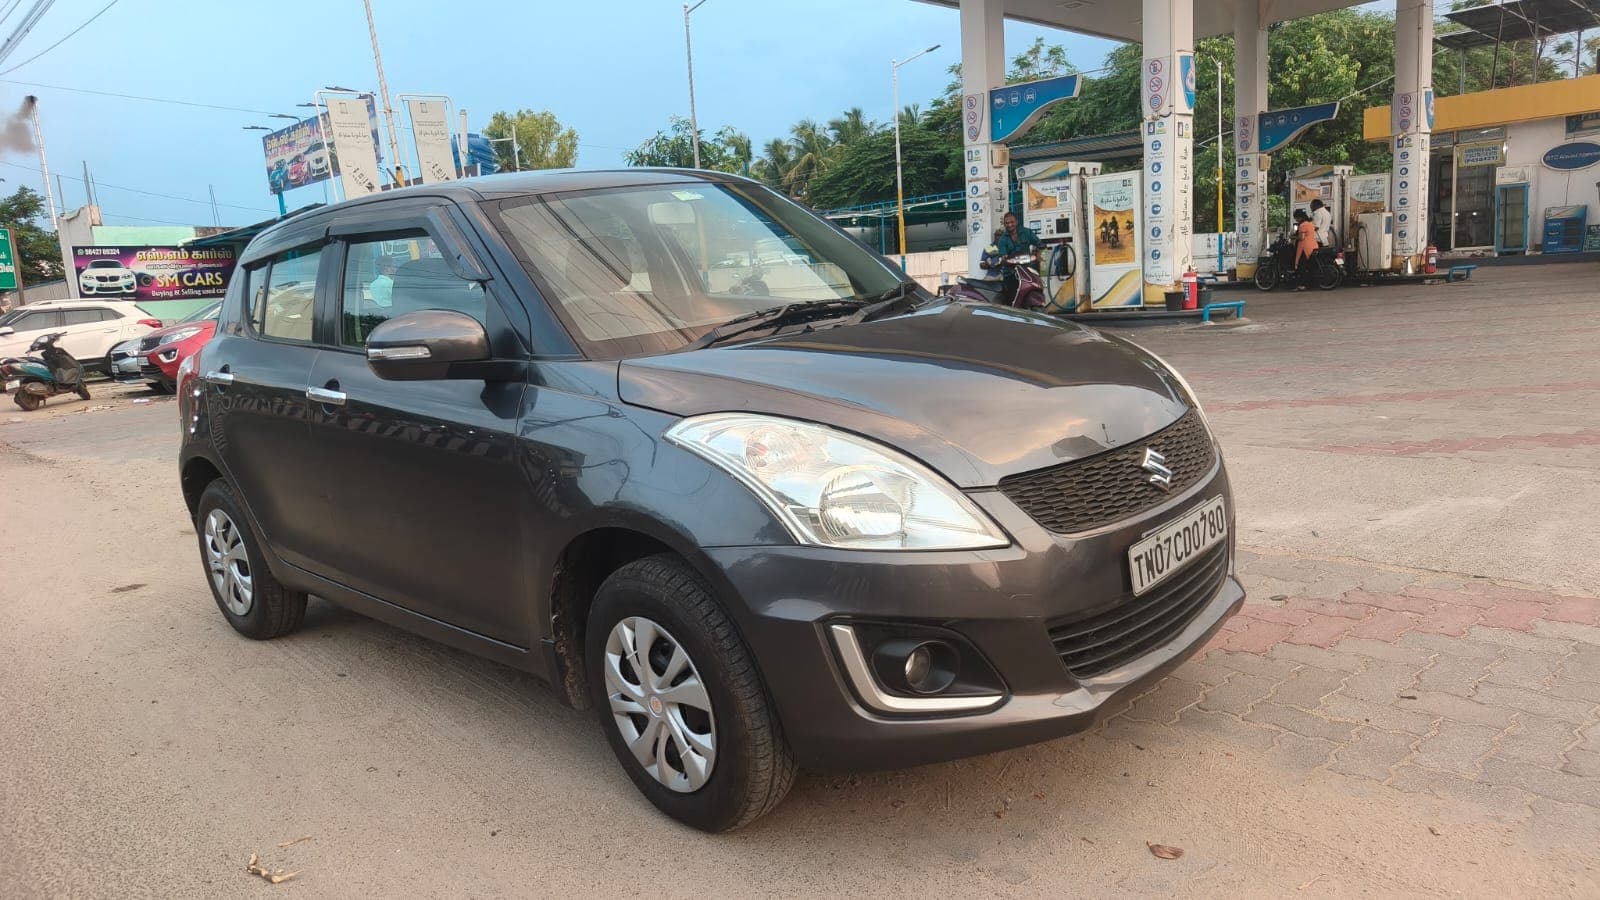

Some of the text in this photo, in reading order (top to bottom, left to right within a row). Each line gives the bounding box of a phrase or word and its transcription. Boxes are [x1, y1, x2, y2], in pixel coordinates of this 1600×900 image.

[997, 118, 1003, 130] 1
[157, 272, 224, 288] SM CARS
[151, 289, 174, 298] Buying
[182, 288, 202, 296] Selling
[1134, 505, 1224, 588] TN07CD0780
